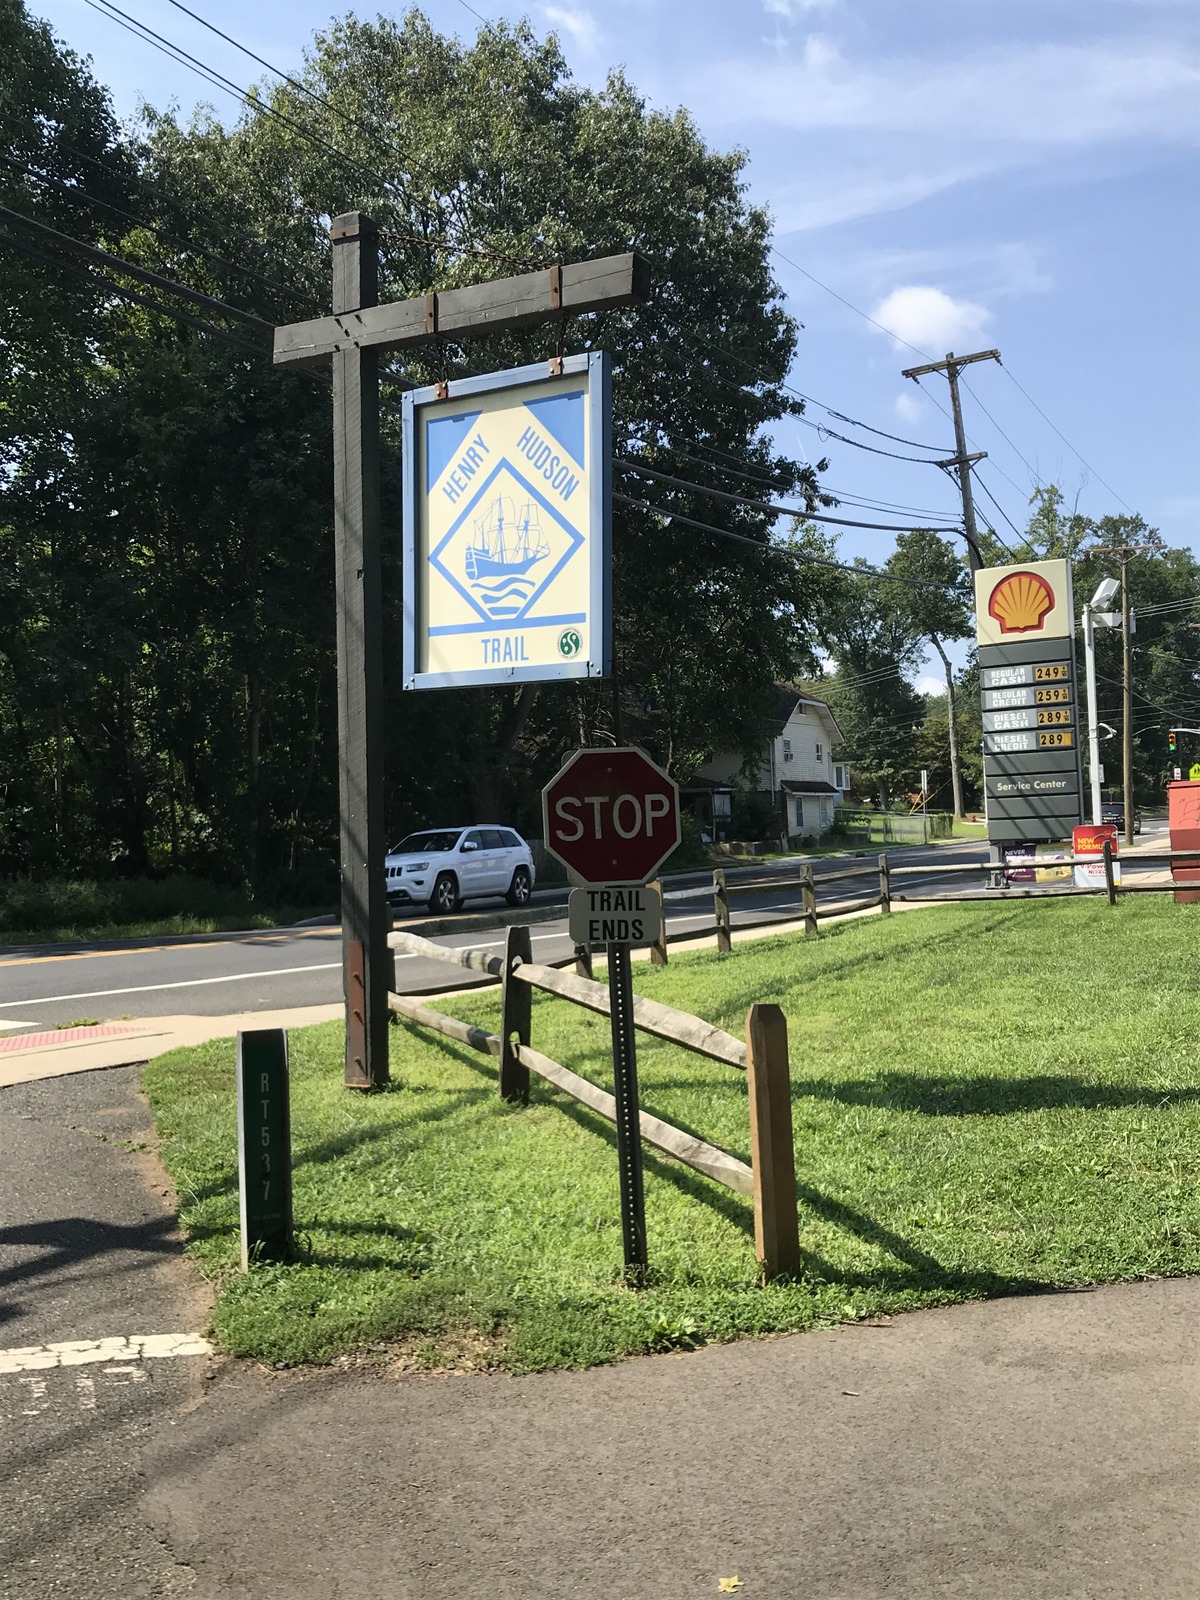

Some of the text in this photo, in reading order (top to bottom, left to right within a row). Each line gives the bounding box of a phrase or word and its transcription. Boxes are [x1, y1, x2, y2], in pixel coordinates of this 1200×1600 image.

[442, 433, 491, 504] HENRY
[516, 426, 580, 502] HUDSON
[481, 636, 529, 664] TRAIL
[991, 668, 1025, 678] REGULAR
[1037, 667, 1059, 678] 249
[992, 676, 1026, 686] CASH
[992, 690, 1027, 699] REGULAR
[1037, 690, 1060, 701] 259
[992, 697, 1026, 707] CREDIT
[994, 712, 1028, 722] DIESEL
[1039, 711, 1061, 723] 289
[994, 720, 1029, 730] CASH
[994, 734, 1028, 743] DIESEL
[1041, 734, 1063, 745] 289
[994, 742, 1028, 752] CREDIT
[997, 780, 1067, 791] Service Center
[555, 794, 670, 841] STOP
[1004, 848, 1026, 856] NEVER
[587, 890, 646, 912] TRAIL
[589, 919, 644, 941] ENDS
